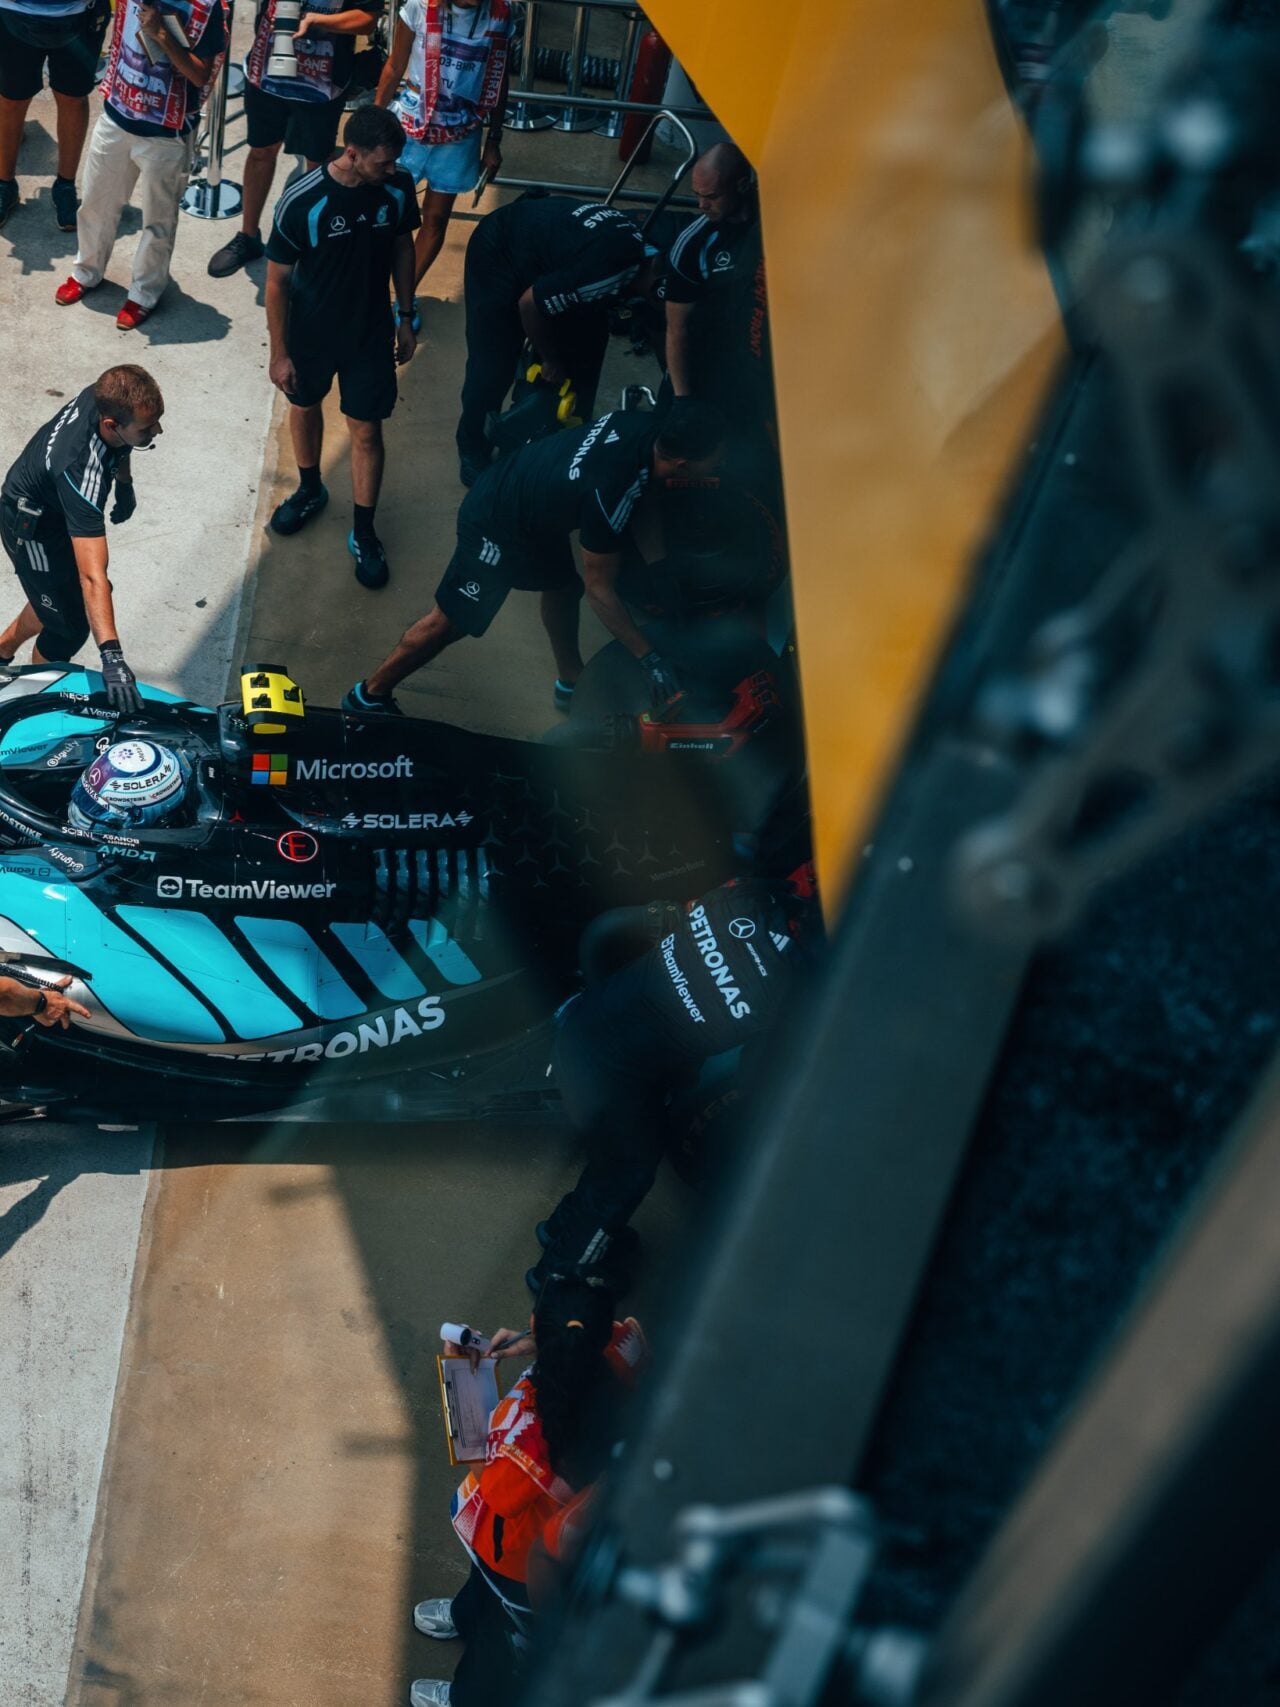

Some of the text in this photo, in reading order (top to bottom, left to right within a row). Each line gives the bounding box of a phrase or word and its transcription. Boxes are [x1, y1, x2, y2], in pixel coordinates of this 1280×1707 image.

[117, 59, 167, 95] MEDIA
[128, 87, 160, 108] LANE
[569, 411, 613, 480] ETRONAS
[87, 706, 120, 719] Vercel
[296, 755, 414, 781] Microsoft
[123, 772, 167, 791] SOLERA
[362, 812, 456, 831] SOLERA
[61, 825, 96, 841] INEOS
[98, 845, 140, 859] AMD
[185, 879, 336, 900] TeamViewer
[689, 904, 752, 1020] PETRONAS
[663, 941, 706, 1024] TeamViewer
